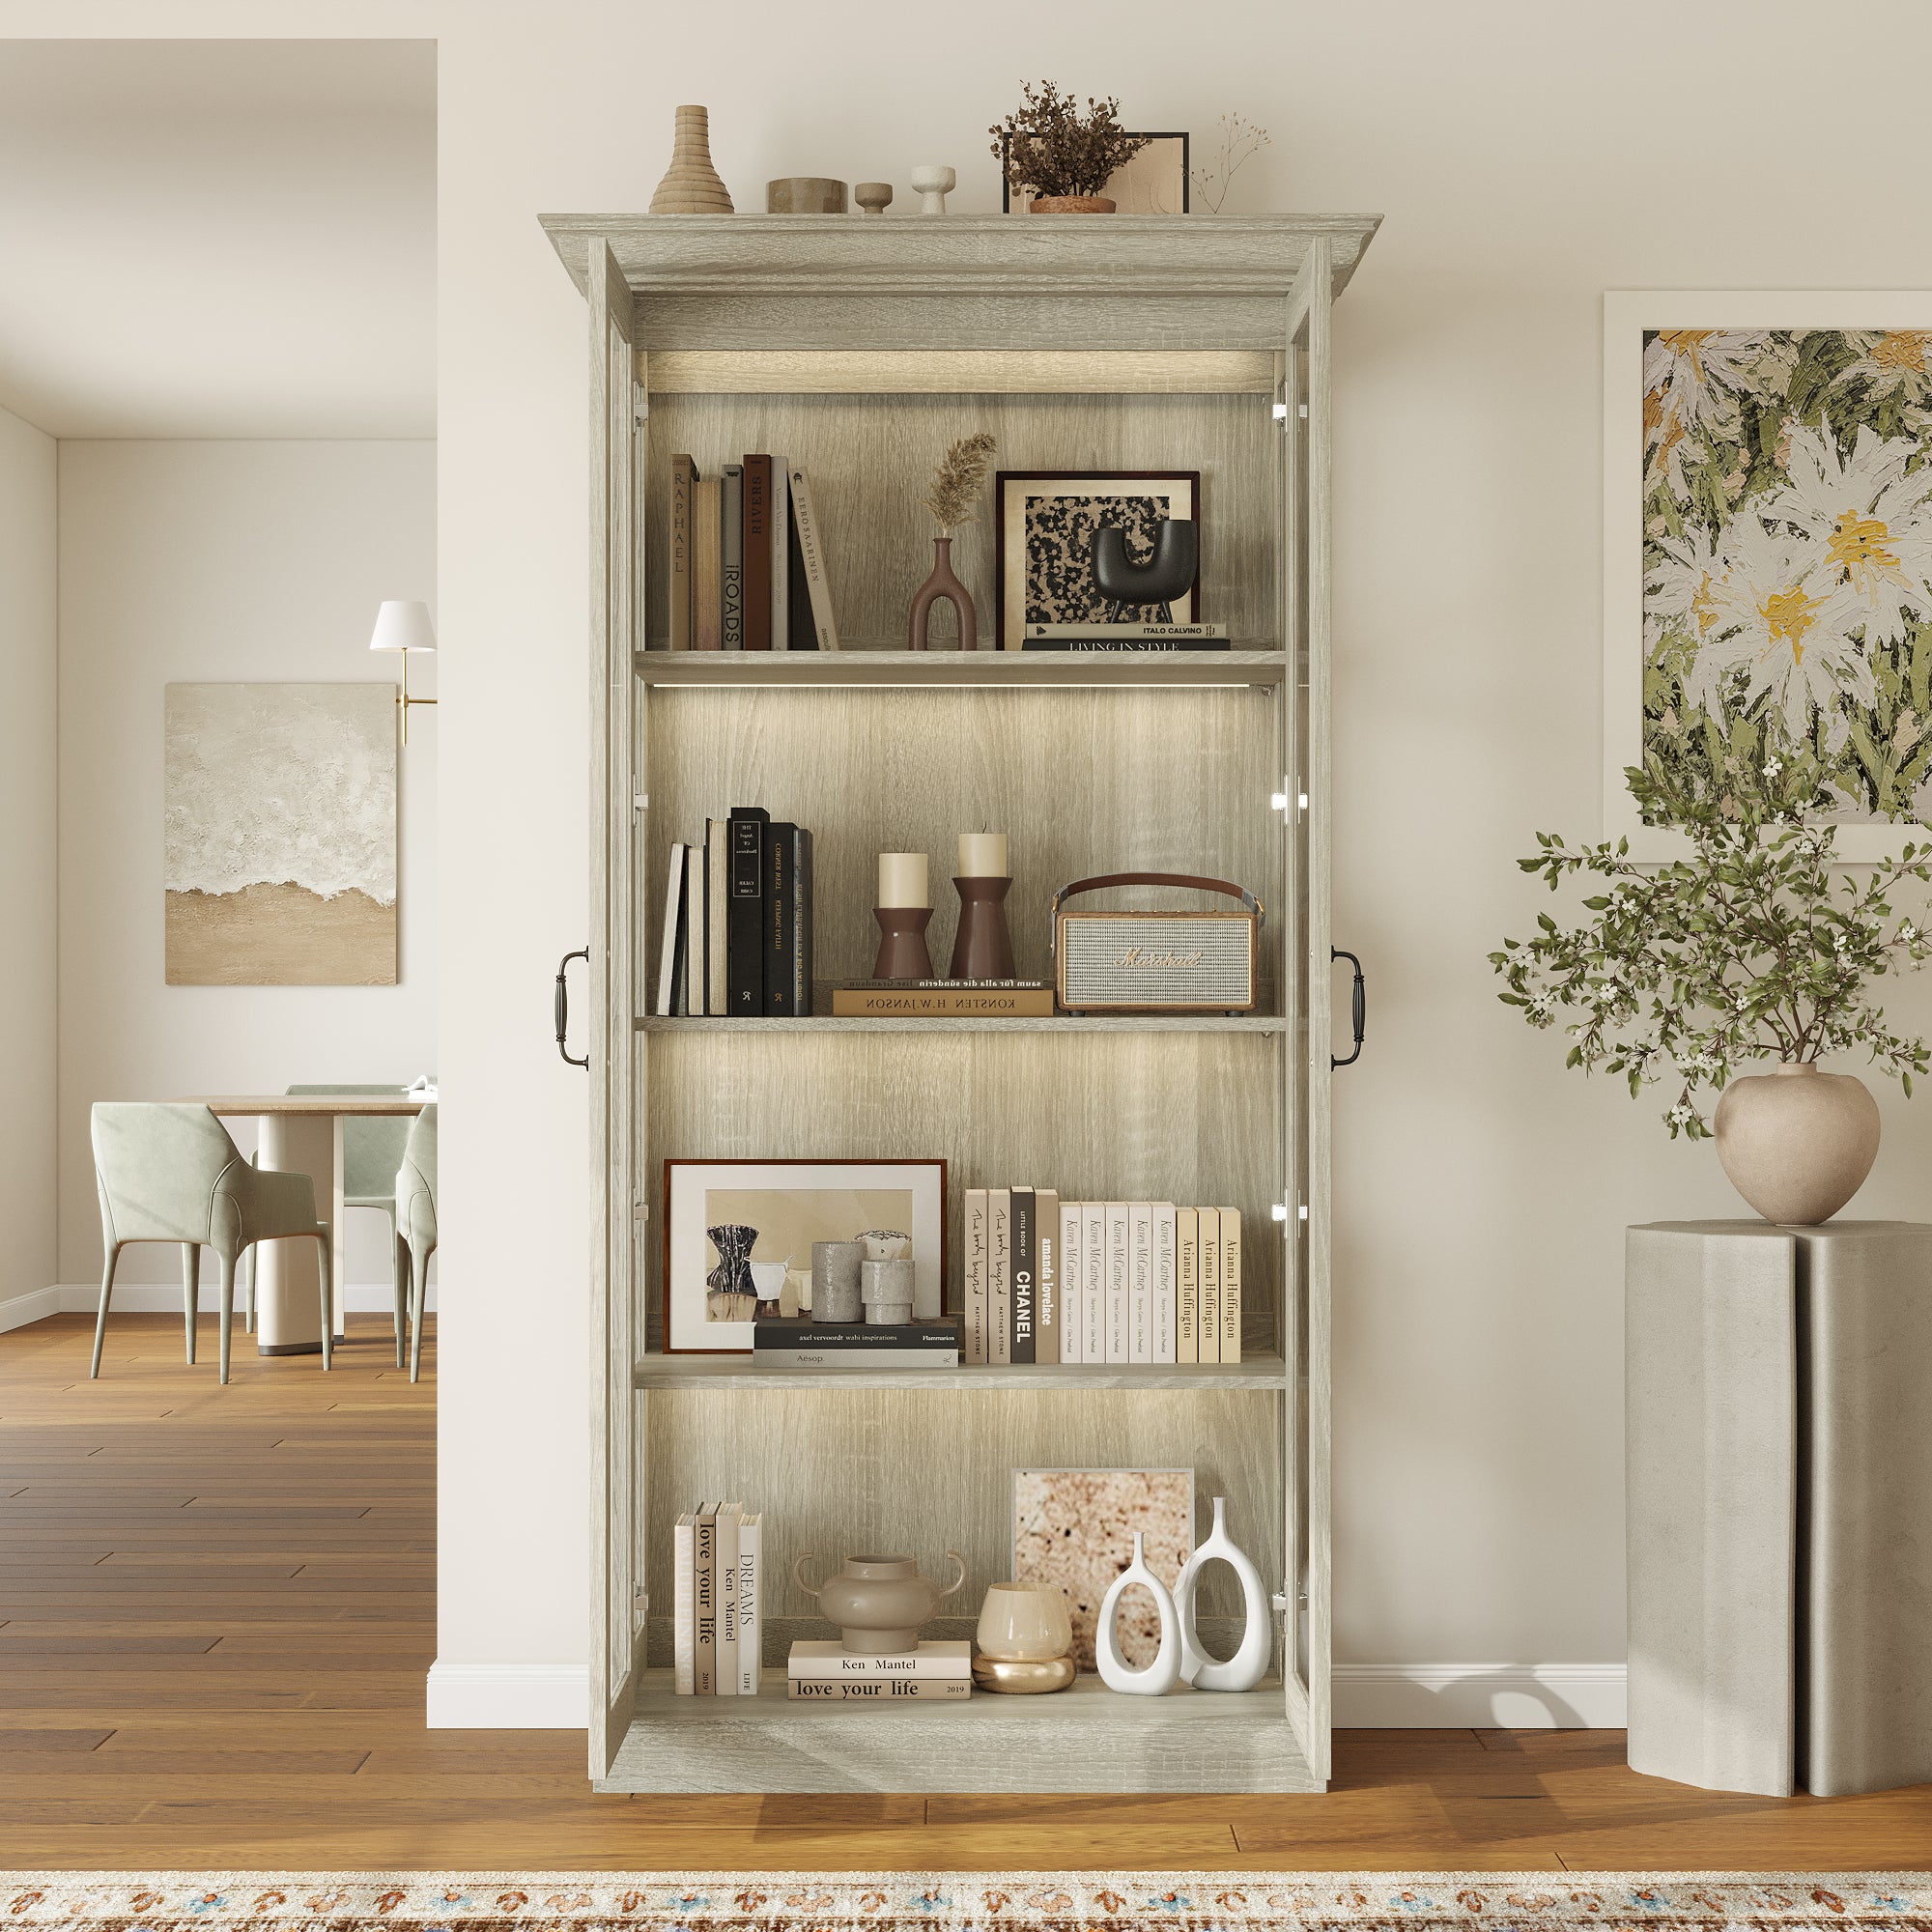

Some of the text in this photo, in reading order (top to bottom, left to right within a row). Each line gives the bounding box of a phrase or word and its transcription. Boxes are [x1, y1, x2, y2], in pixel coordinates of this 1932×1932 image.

[674, 473, 684, 573] RAPHAEL
[753, 476, 762, 535] RIVERS
[798, 497, 819, 582] EERO SAARINEN
[725, 570, 739, 643] ROADS
[1069, 642, 1115, 651] LIVING
[1114, 947, 1204, 968] Marshall
[967, 1208, 985, 1295] The body beyond
[990, 1208, 1009, 1295] The body beyond
[1041, 1238, 1054, 1325] amanda lovelace
[1063, 1220, 1078, 1292] Karen McCartney
[1086, 1220, 1101, 1292] Karen McCartney
[1110, 1220, 1124, 1292] Karen McCartney
[1133, 1220, 1149, 1292] Karen McCartney
[1156, 1220, 1172, 1292] Karen McCartney
[1016, 1271, 1031, 1343] CHANEL
[1180, 1240, 1194, 1339] Arianna Huffington
[1202, 1240, 1215, 1339] Arianna Huffington
[1224, 1240, 1237, 1339] Arianna Huffington
[696, 1522, 714, 1644] love your life
[741, 1554, 753, 1626] DREAMS
[726, 1602, 735, 1642] Mantel
[796, 1681, 918, 1699] love your life
[842, 1660, 917, 1669] Ken Mantel
